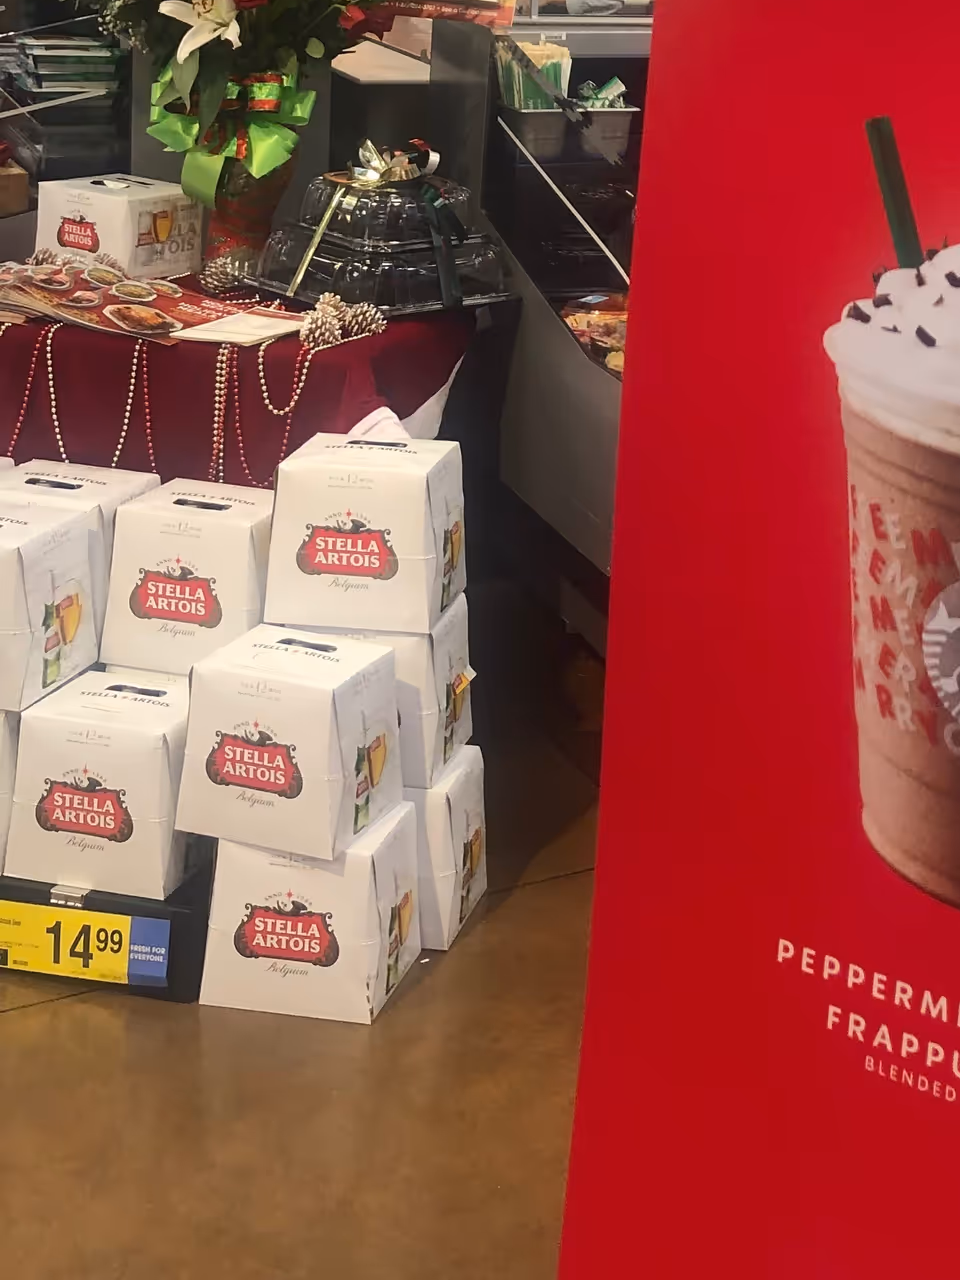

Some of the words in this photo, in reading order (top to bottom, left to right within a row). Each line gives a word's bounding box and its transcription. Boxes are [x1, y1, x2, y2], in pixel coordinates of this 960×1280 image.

[63, 223, 92, 236] STELLA
[63, 232, 92, 246] ARTOIS
[24, 471, 60, 481] STELLA
[69, 476, 108, 487] ARTOIS
[315, 536, 380, 554] STELLA
[314, 552, 380, 568] ARTOIS
[147, 581, 206, 601] STELLA
[145, 596, 206, 616] ARTOIS
[251, 642, 289, 652] STELLA
[301, 650, 341, 664] ARTOIS
[80, 691, 118, 699] STELLA
[127, 697, 171, 708] ARTOIS
[224, 745, 285, 769] STELLA
[223, 761, 286, 785] ARTOIS
[53, 792, 116, 814] STELLA
[52, 809, 116, 829] ARTOIS
[254, 917, 321, 938] STELLA
[151, 946, 167, 954] FOR
[252, 933, 321, 954] ARTOIS
[864, 1055, 958, 1103] BLENDED
